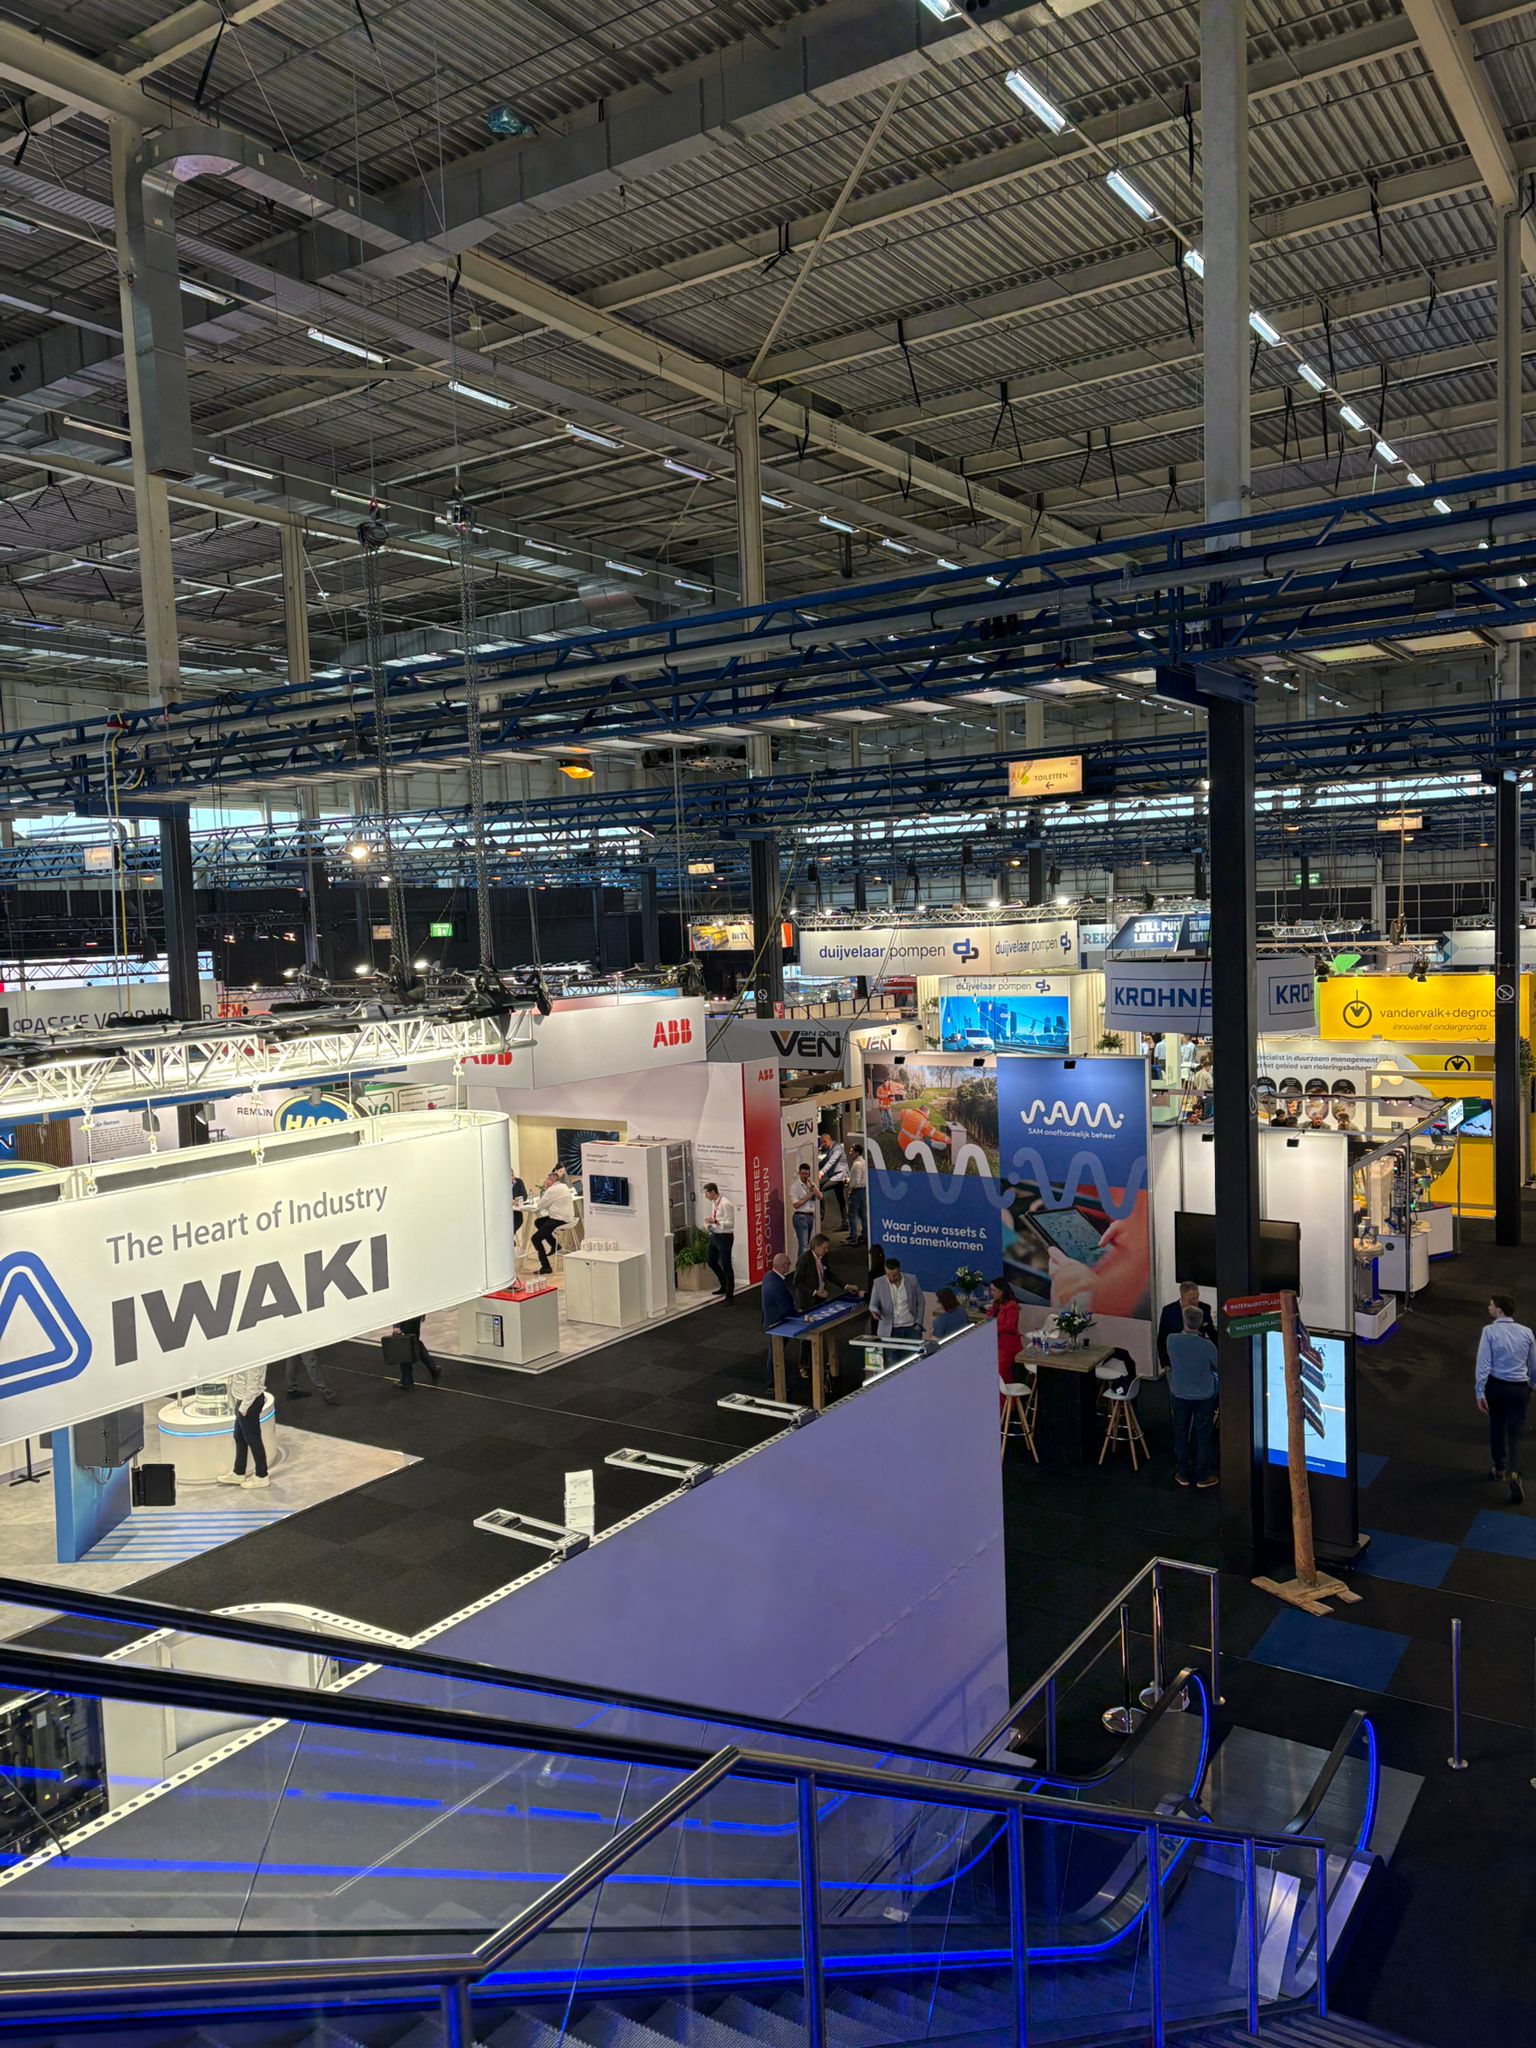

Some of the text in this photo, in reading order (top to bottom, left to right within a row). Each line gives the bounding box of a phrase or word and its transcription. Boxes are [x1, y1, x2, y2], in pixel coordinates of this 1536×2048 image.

[1034, 772, 1068, 781] TOILETTEN
[1134, 920, 1181, 933] STILL PUM
[1134, 932, 1154, 943] LIKE
[1155, 932, 1173, 943] IT'S
[819, 943, 946, 960] duijvelaar pompen
[995, 939, 1058, 956] duijvelaar pompen
[956, 981, 1032, 993] duijvelaar pompen
[217, 1003, 242, 1018] JFM
[1380, 1007, 1496, 1021] vandervalk+degroo
[652, 1018, 692, 1048] ABB
[1392, 1023, 1487, 1033] innovatief ondergronds
[769, 1030, 841, 1059] VEN
[1258, 1054, 1285, 1063] pecialist
[1294, 1055, 1329, 1063] duurzaam
[1331, 1056, 1378, 1064] management
[758, 1068, 774, 1082] ABB
[787, 1119, 814, 1138] VEN
[1027, 1127, 1117, 1140] SAM onafhankelijk beheer
[752, 1156, 764, 1271] ENGINEERED
[762, 1167, 773, 1268] TO OUTRUN
[106, 1186, 388, 1265] The Heart of Industry
[882, 1218, 987, 1239] Waar jouw assets &
[882, 1231, 984, 1252] data samenkomen
[111, 1233, 390, 1367] IWAKI
